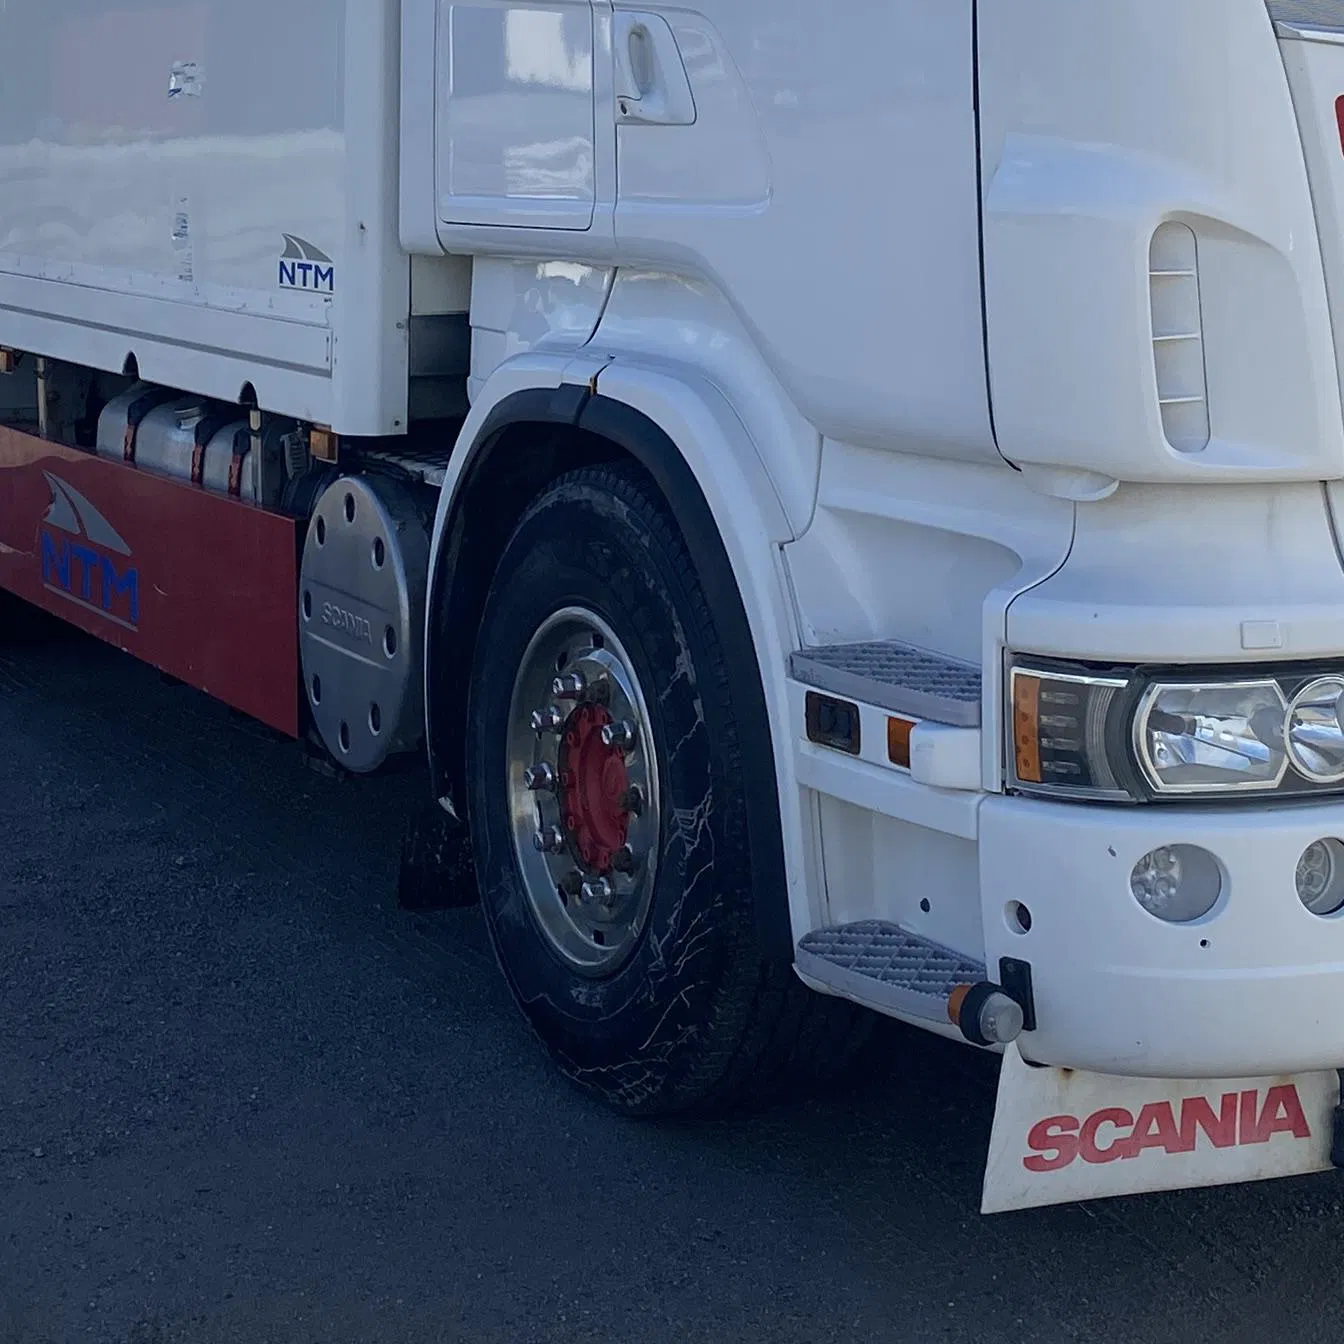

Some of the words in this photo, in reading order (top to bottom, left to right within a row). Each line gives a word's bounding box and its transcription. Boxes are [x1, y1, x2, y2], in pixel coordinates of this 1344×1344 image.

[279, 261, 334, 292] NTM
[40, 529, 140, 625] NTM
[1022, 1083, 1312, 1173] SCANIA
